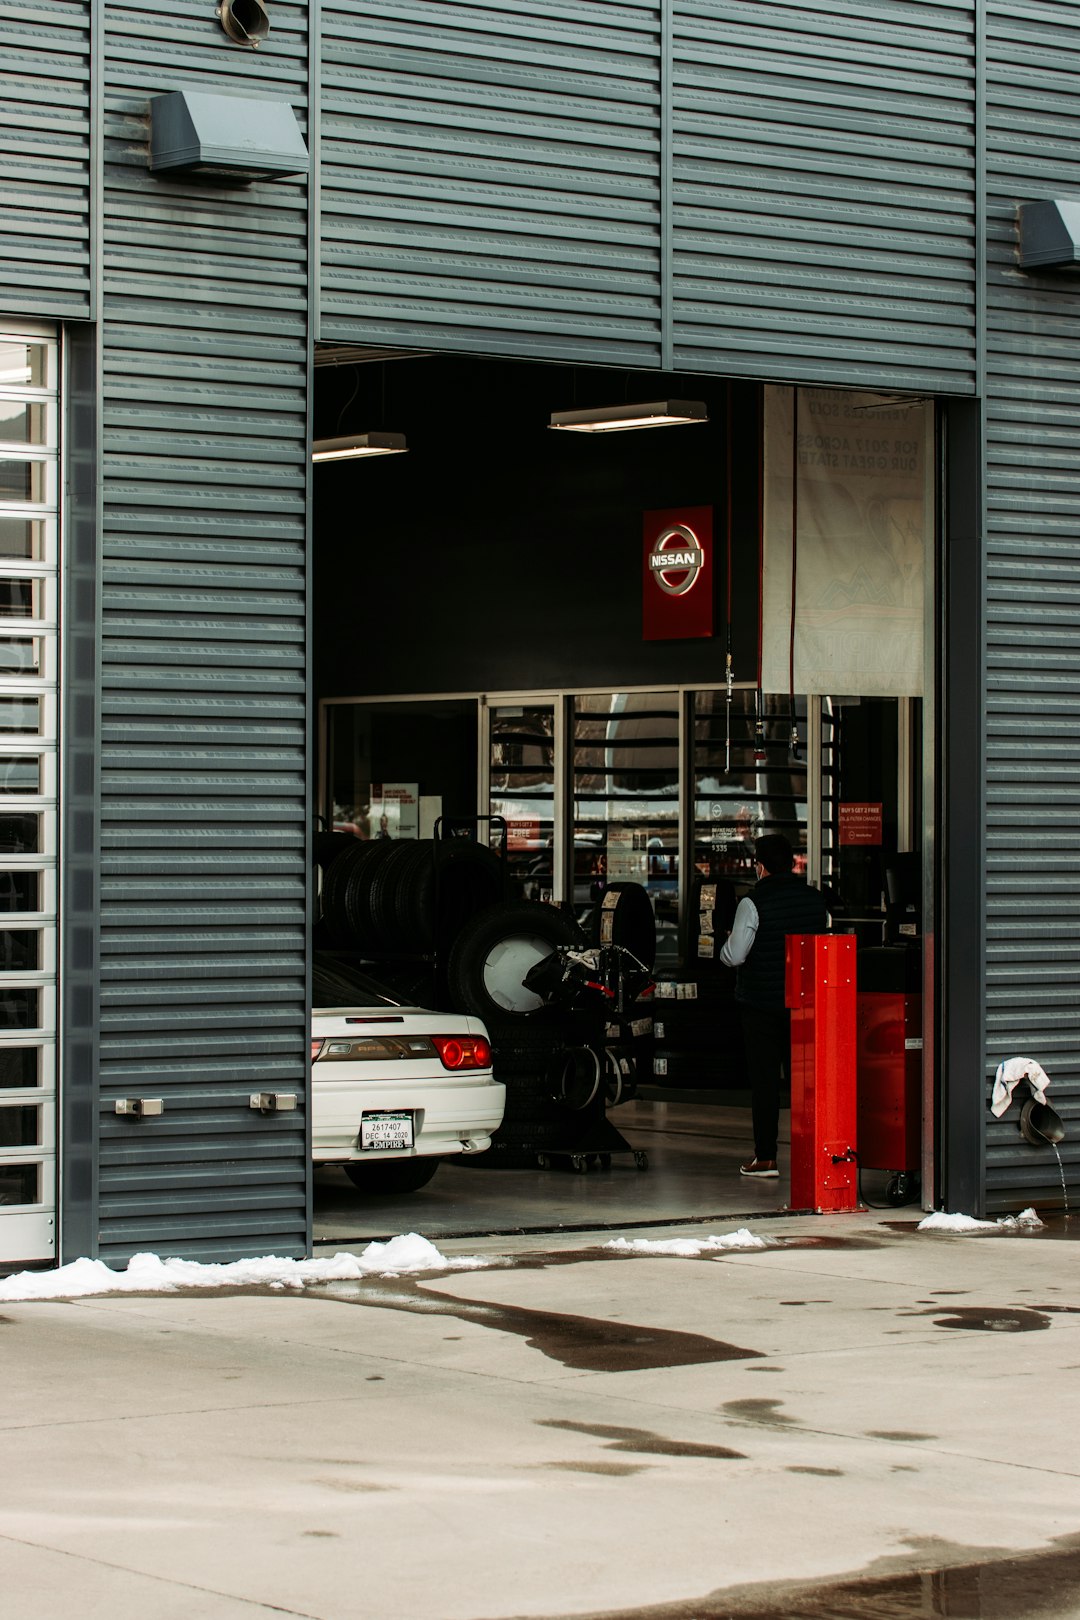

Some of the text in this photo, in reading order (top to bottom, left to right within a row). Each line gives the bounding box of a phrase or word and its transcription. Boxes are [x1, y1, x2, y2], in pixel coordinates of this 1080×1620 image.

[652, 552, 695, 567] NISSAN
[513, 829, 530, 837] FREE
[372, 1123, 401, 1131] 2617407
[374, 1141, 403, 1149] EMPIRE
